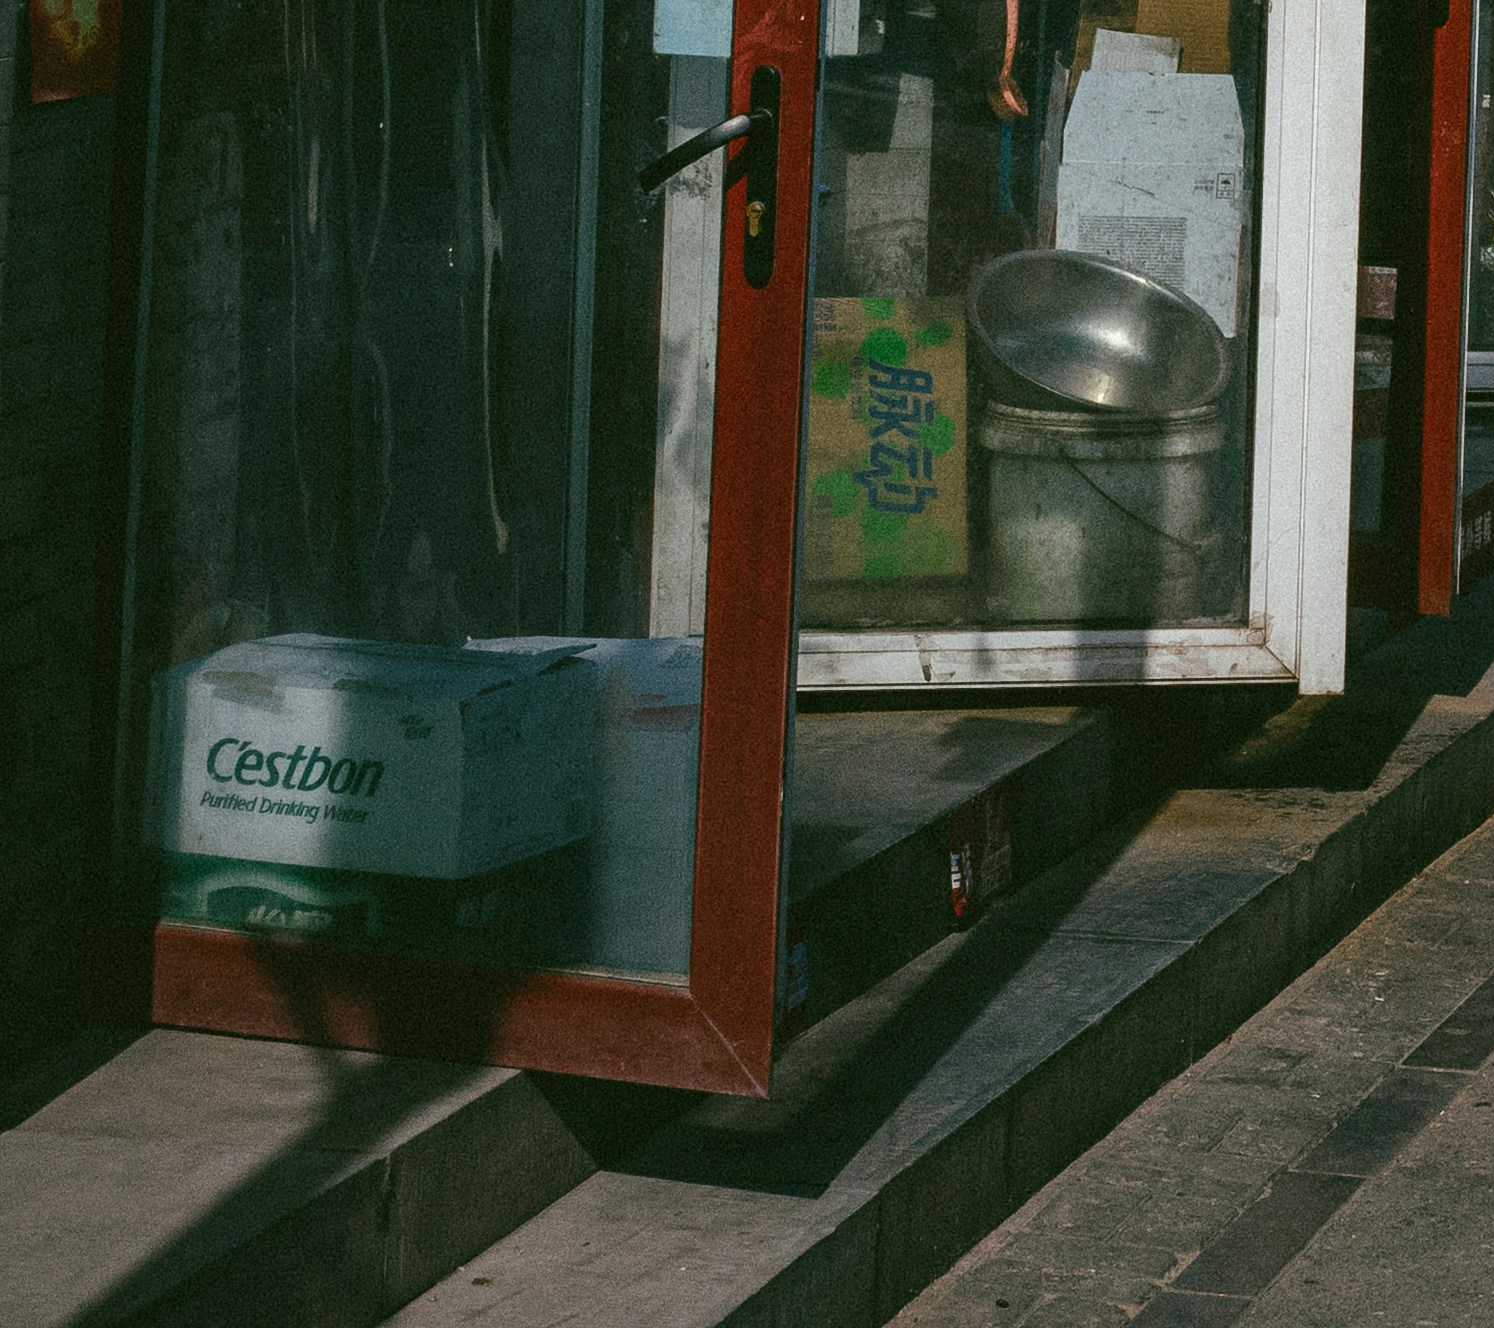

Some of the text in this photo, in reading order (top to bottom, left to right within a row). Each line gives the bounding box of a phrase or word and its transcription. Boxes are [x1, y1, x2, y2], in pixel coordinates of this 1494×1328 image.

[854, 356, 938, 514] 脉动
[206, 737, 385, 797] C'estbon
[200, 791, 371, 824] Purified Drinking Water
